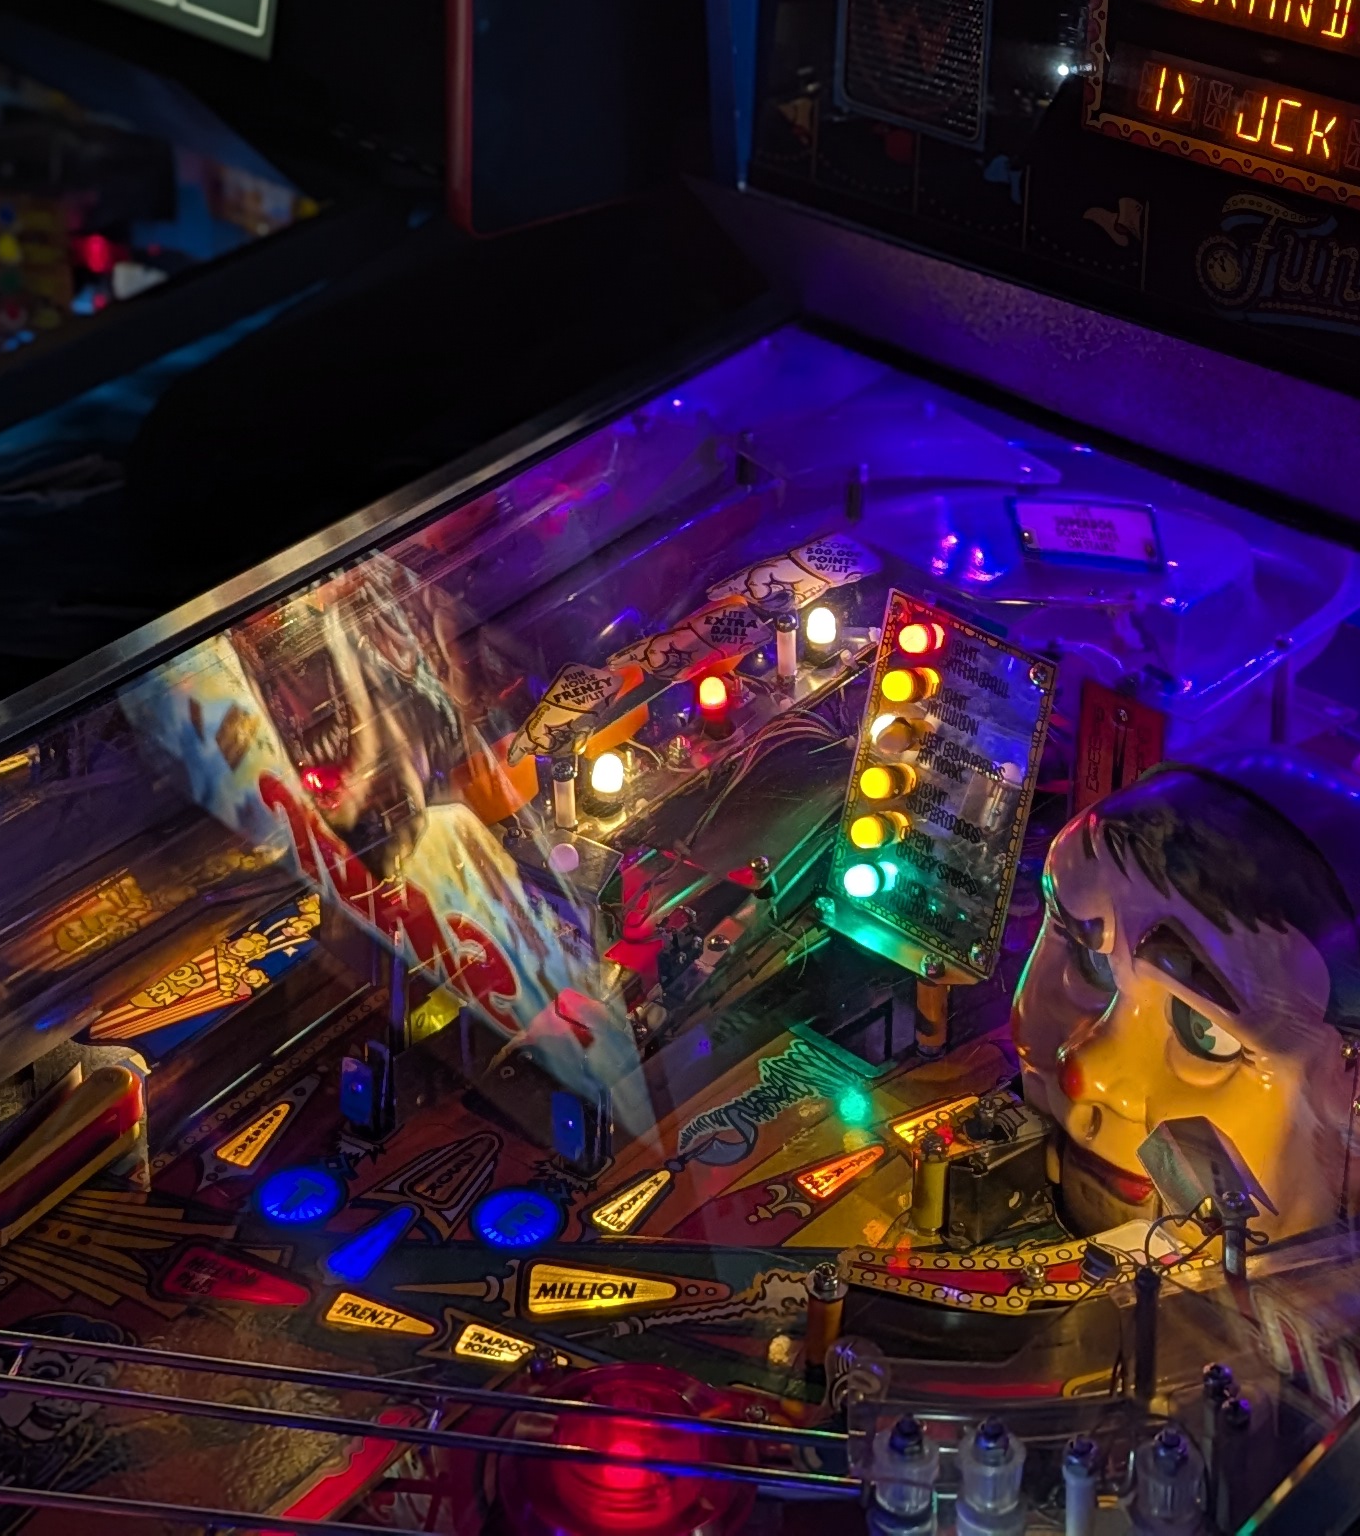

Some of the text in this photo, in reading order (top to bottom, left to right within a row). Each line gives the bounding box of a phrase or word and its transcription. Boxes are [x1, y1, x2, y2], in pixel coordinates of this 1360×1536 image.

[703, 615, 758, 629] EXTRA
[563, 670, 587, 685] FUN
[552, 678, 614, 704] FRENZY
[534, 1280, 637, 1301] MILLION
[336, 1301, 406, 1328] FRENZY
[469, 1330, 531, 1354] TRAPDOO
